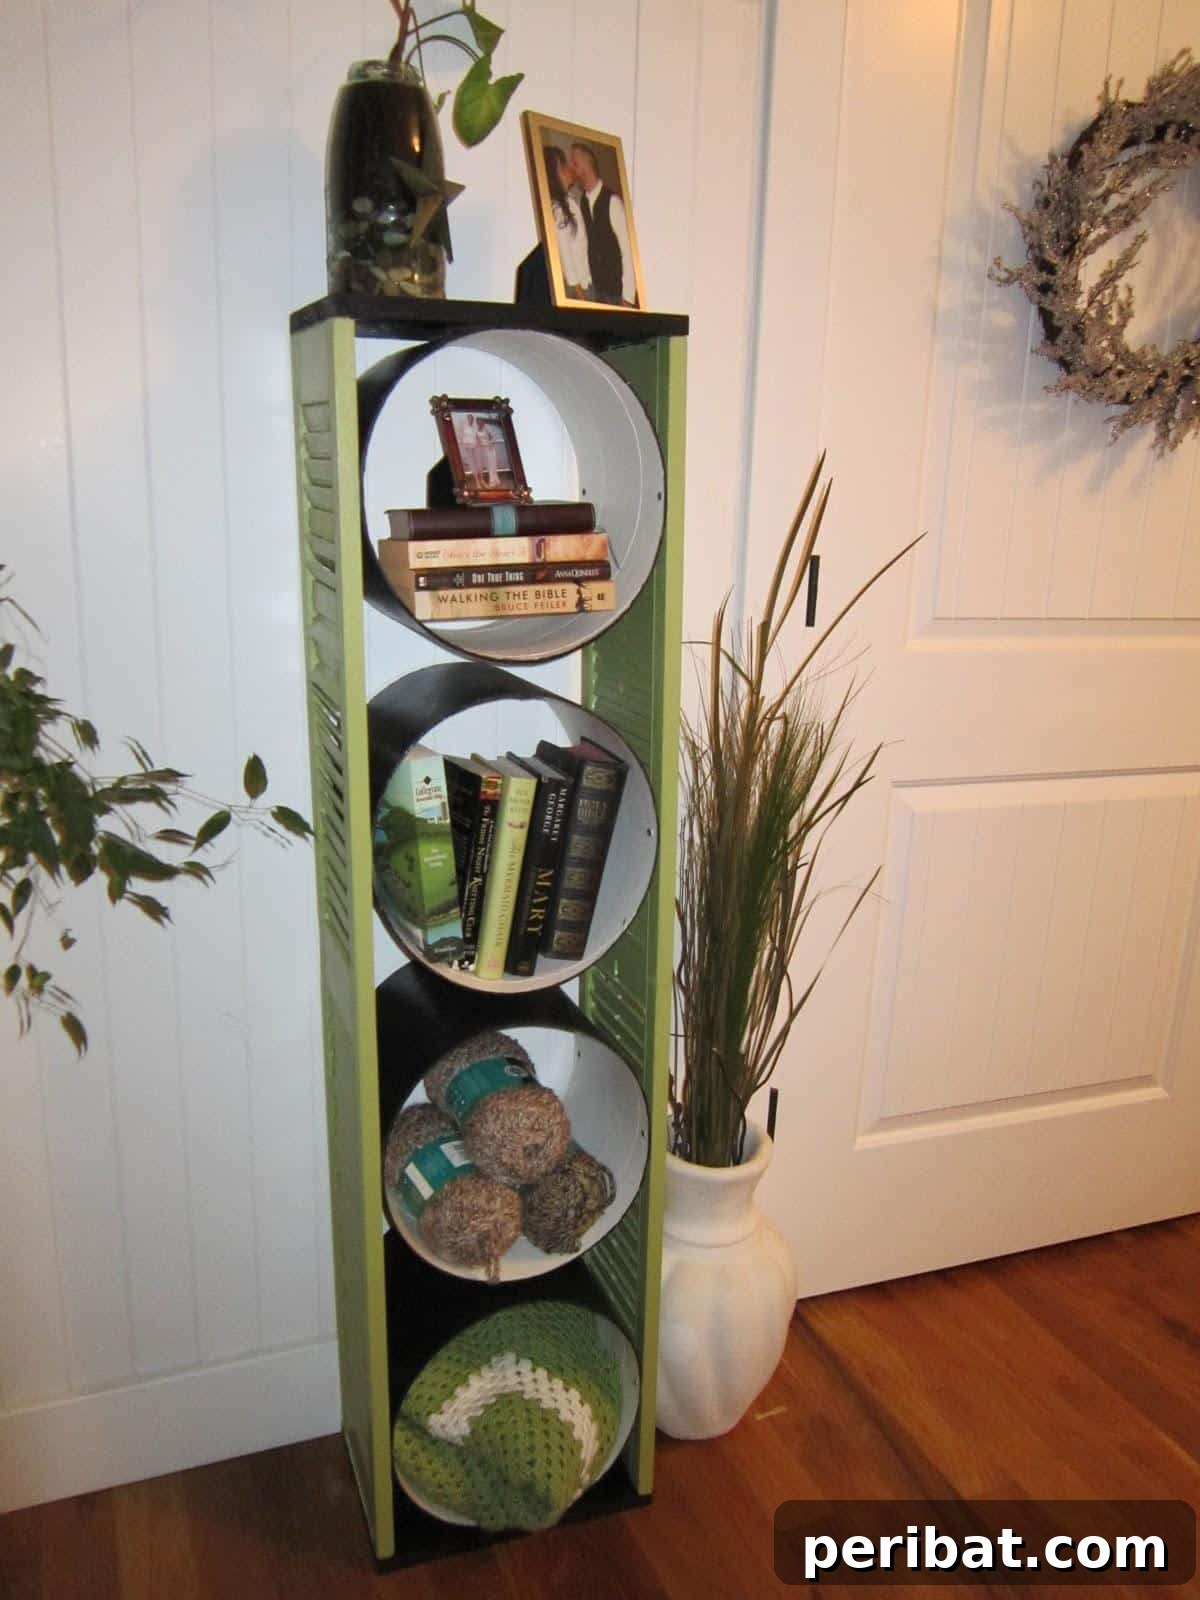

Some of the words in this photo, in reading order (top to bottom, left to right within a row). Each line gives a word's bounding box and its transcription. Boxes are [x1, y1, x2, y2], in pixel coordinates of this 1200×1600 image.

[505, 570, 524, 582] THING
[439, 591, 499, 603] WALKING
[505, 590, 528, 601] THE
[534, 589, 567, 600] BIBLE
[495, 602, 529, 612] BRUCE
[534, 600, 567, 609] FEILER
[542, 793, 557, 834] GEORGE
[550, 788, 568, 841] MARGARET
[528, 868, 555, 936] MARY
